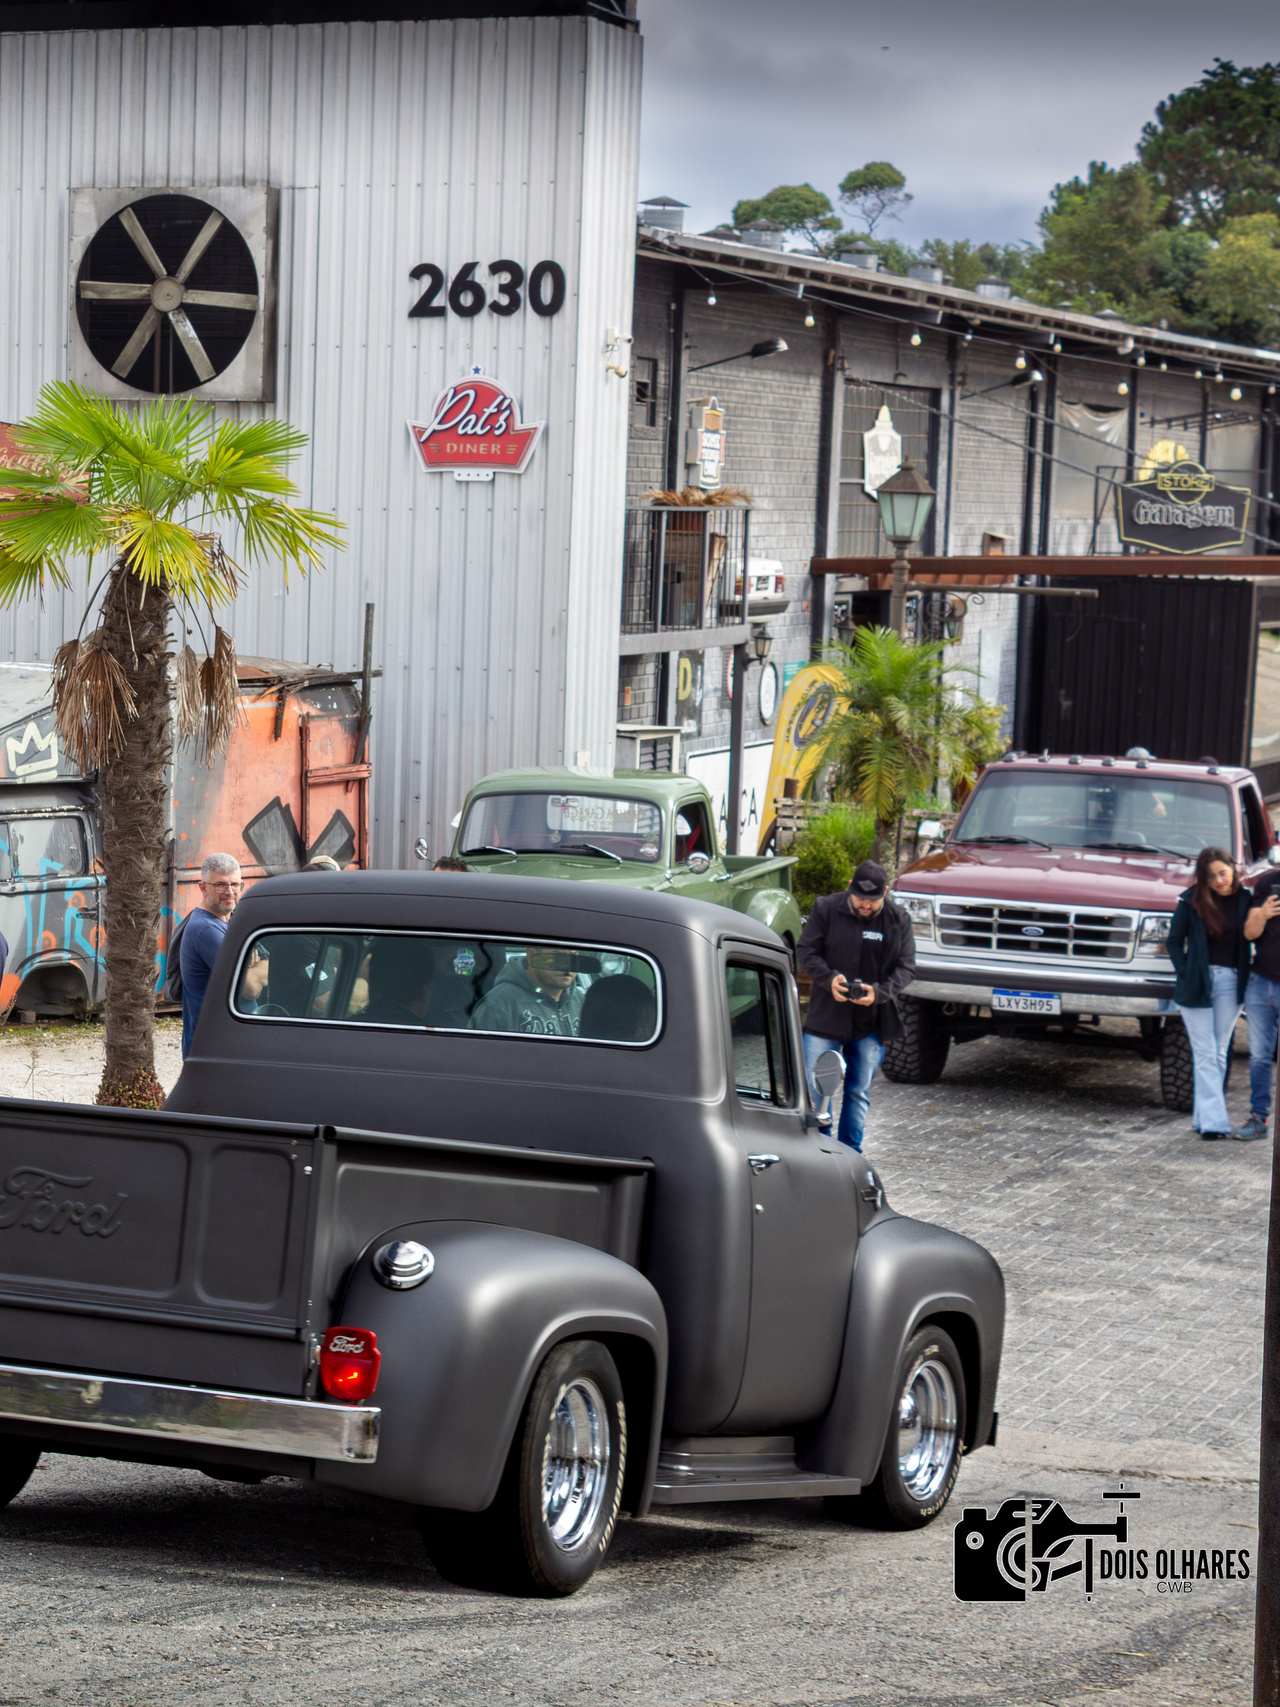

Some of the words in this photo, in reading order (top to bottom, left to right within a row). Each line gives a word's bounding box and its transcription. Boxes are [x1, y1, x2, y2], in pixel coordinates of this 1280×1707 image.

[407, 259, 567, 318] 2630
[419, 386, 513, 444] Pat's
[445, 442, 502, 455] DINER
[1163, 475, 1210, 488] STORE
[1133, 499, 1235, 529] Garagem
[998, 996, 1053, 1012] LXY3H95
[329, 1335, 365, 1354] Ford
